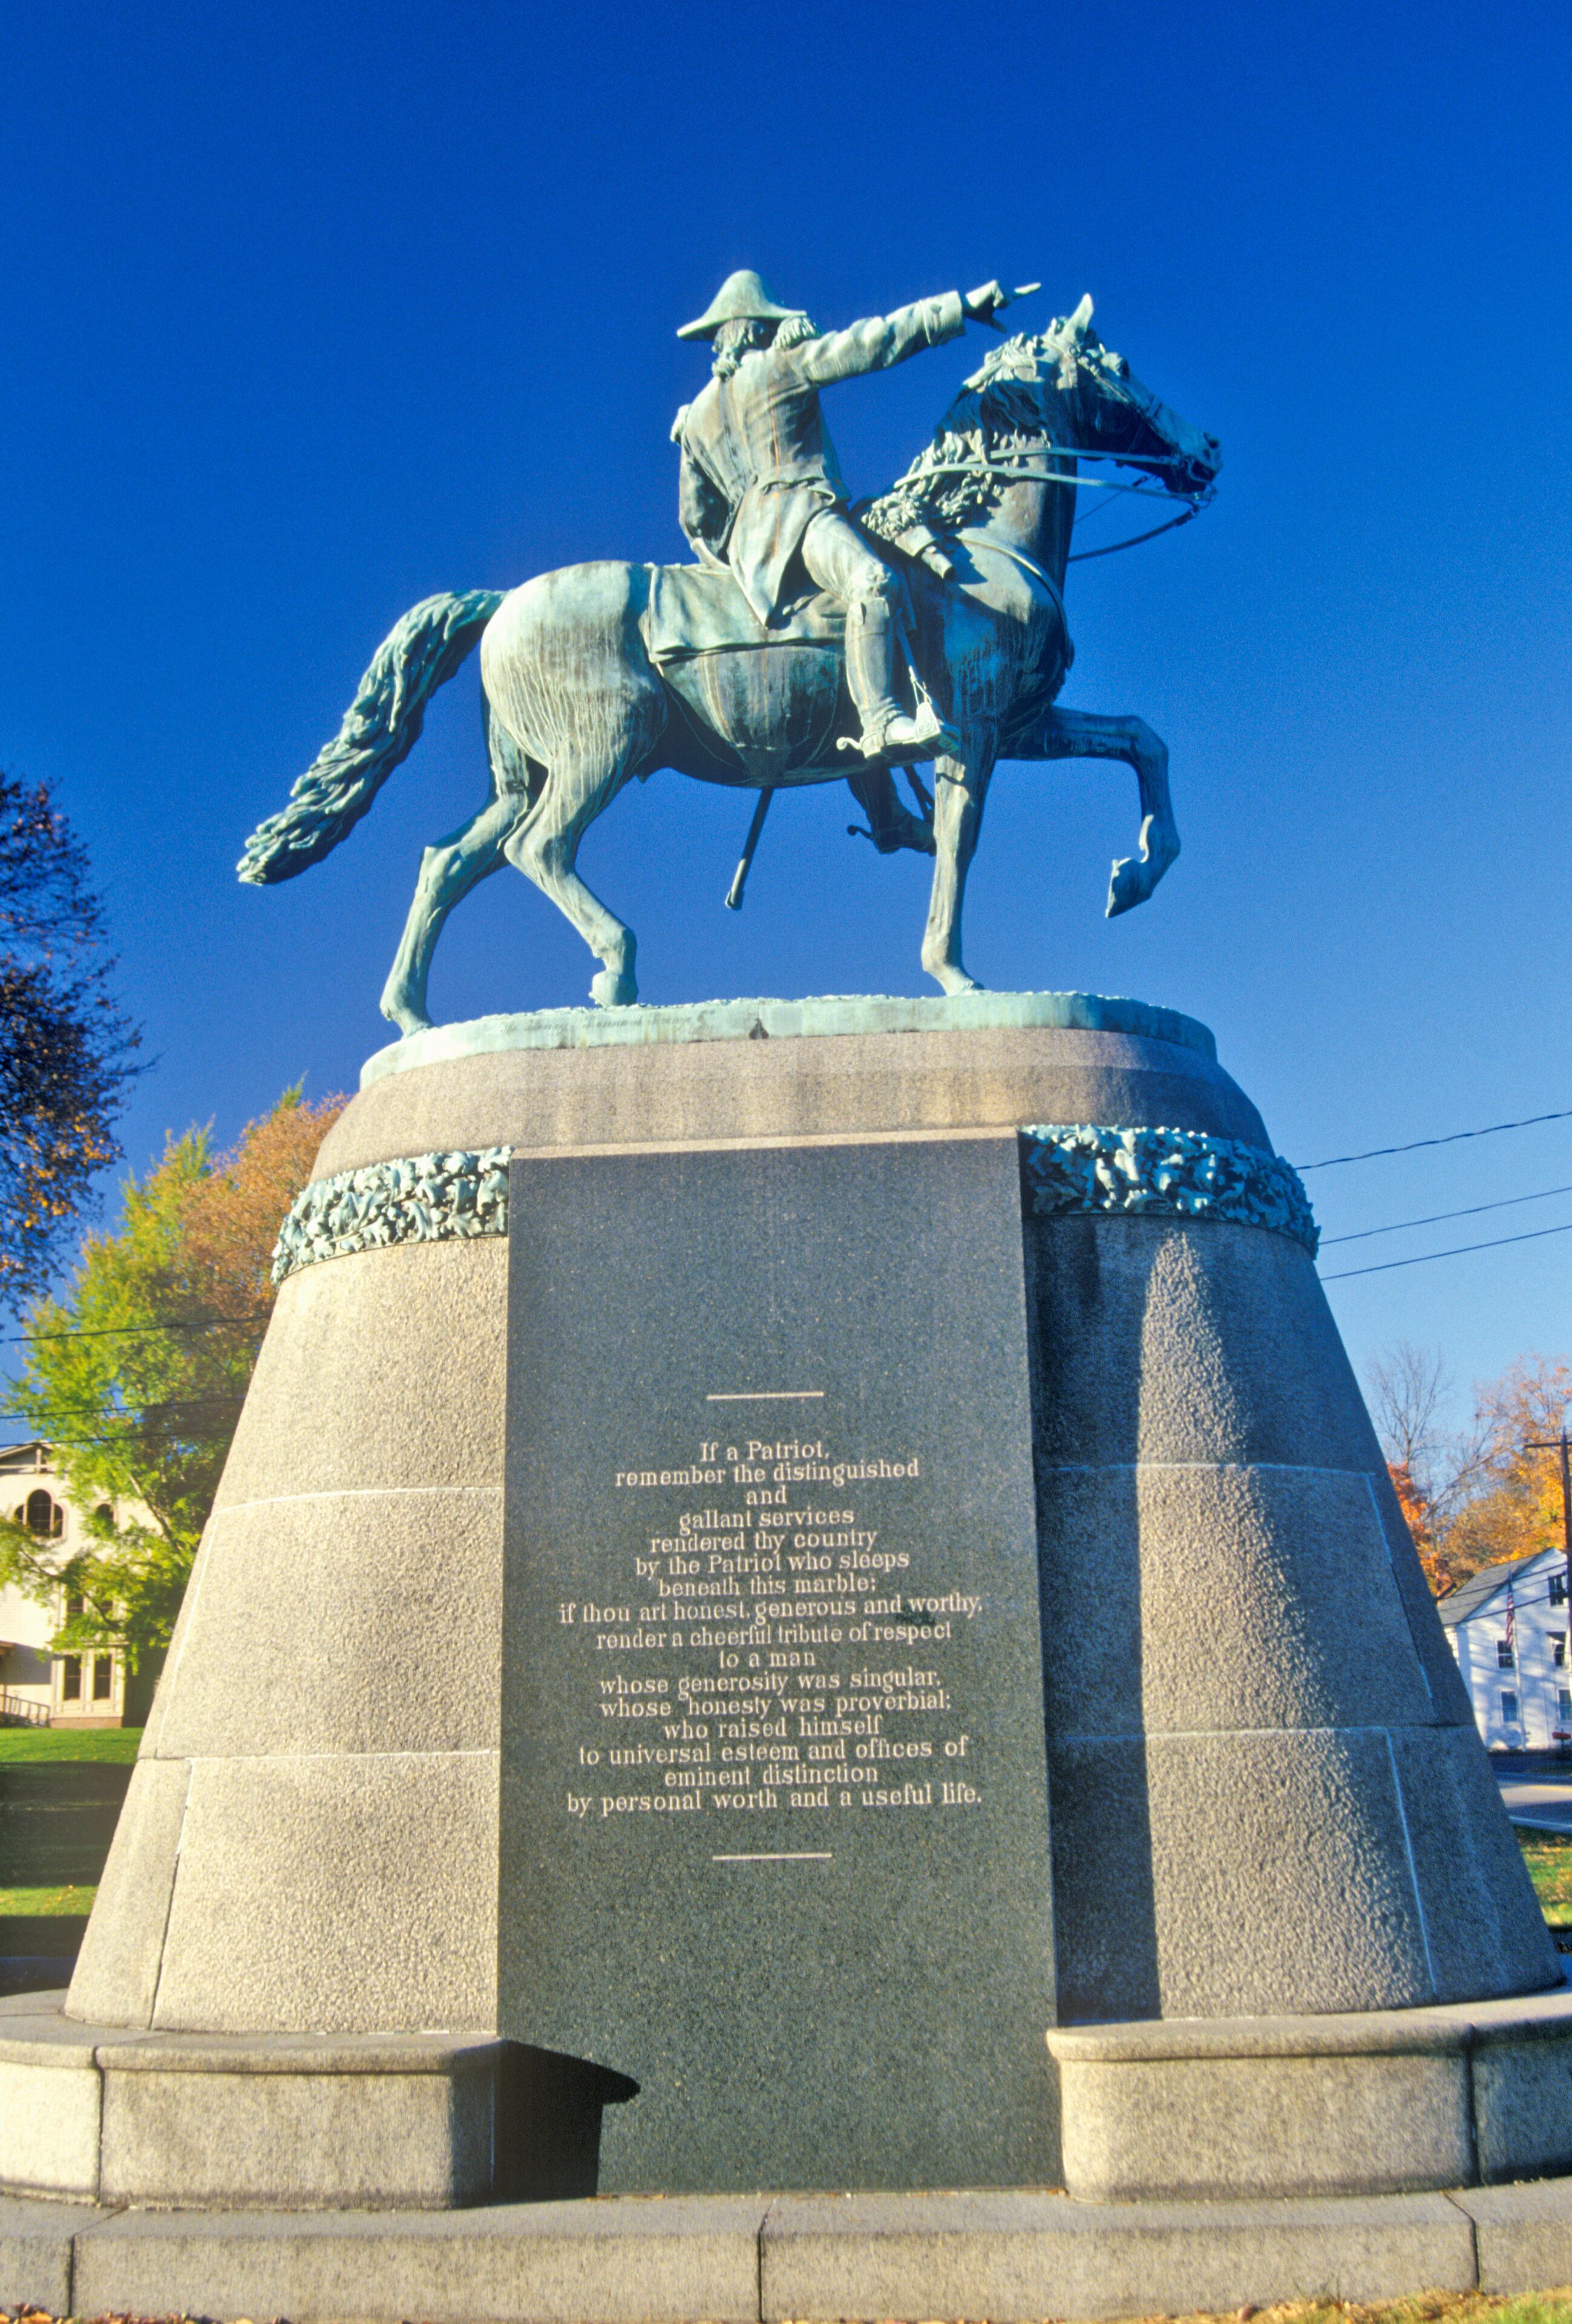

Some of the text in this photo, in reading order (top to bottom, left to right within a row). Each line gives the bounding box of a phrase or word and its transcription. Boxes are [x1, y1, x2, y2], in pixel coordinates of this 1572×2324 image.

[699, 1442, 719, 1462] If
[727, 1448, 738, 1460] a
[615, 1457, 919, 1487] remember the distinguished
[747, 1486, 787, 1505] and
[679, 1506, 854, 1536] gallant services
[650, 1529, 878, 1554] rendered thy country
[635, 1549, 909, 1581] by the Patriot who sleeps
[659, 1572, 876, 1597] beneath this marble;
[558, 1603, 576, 1623] if
[582, 1603, 630, 1623] thou
[640, 1603, 666, 1621] art
[755, 1599, 856, 1626] generous
[863, 1594, 902, 1615] and
[596, 1621, 951, 1650] render a cheerful tribute of respect
[719, 1650, 816, 1669] to a man
[600, 1675, 669, 1694] whose
[678, 1671, 788, 1700] generosity
[797, 1673, 840, 1689] was
[600, 1689, 951, 1719] whose honesty was proverbial;
[663, 1715, 882, 1739] who raised himself
[579, 1735, 969, 1765] to universal esteem and offices of
[664, 1762, 879, 1787] eminent distinction
[567, 1782, 981, 1818] by personal worth and a useful life.
